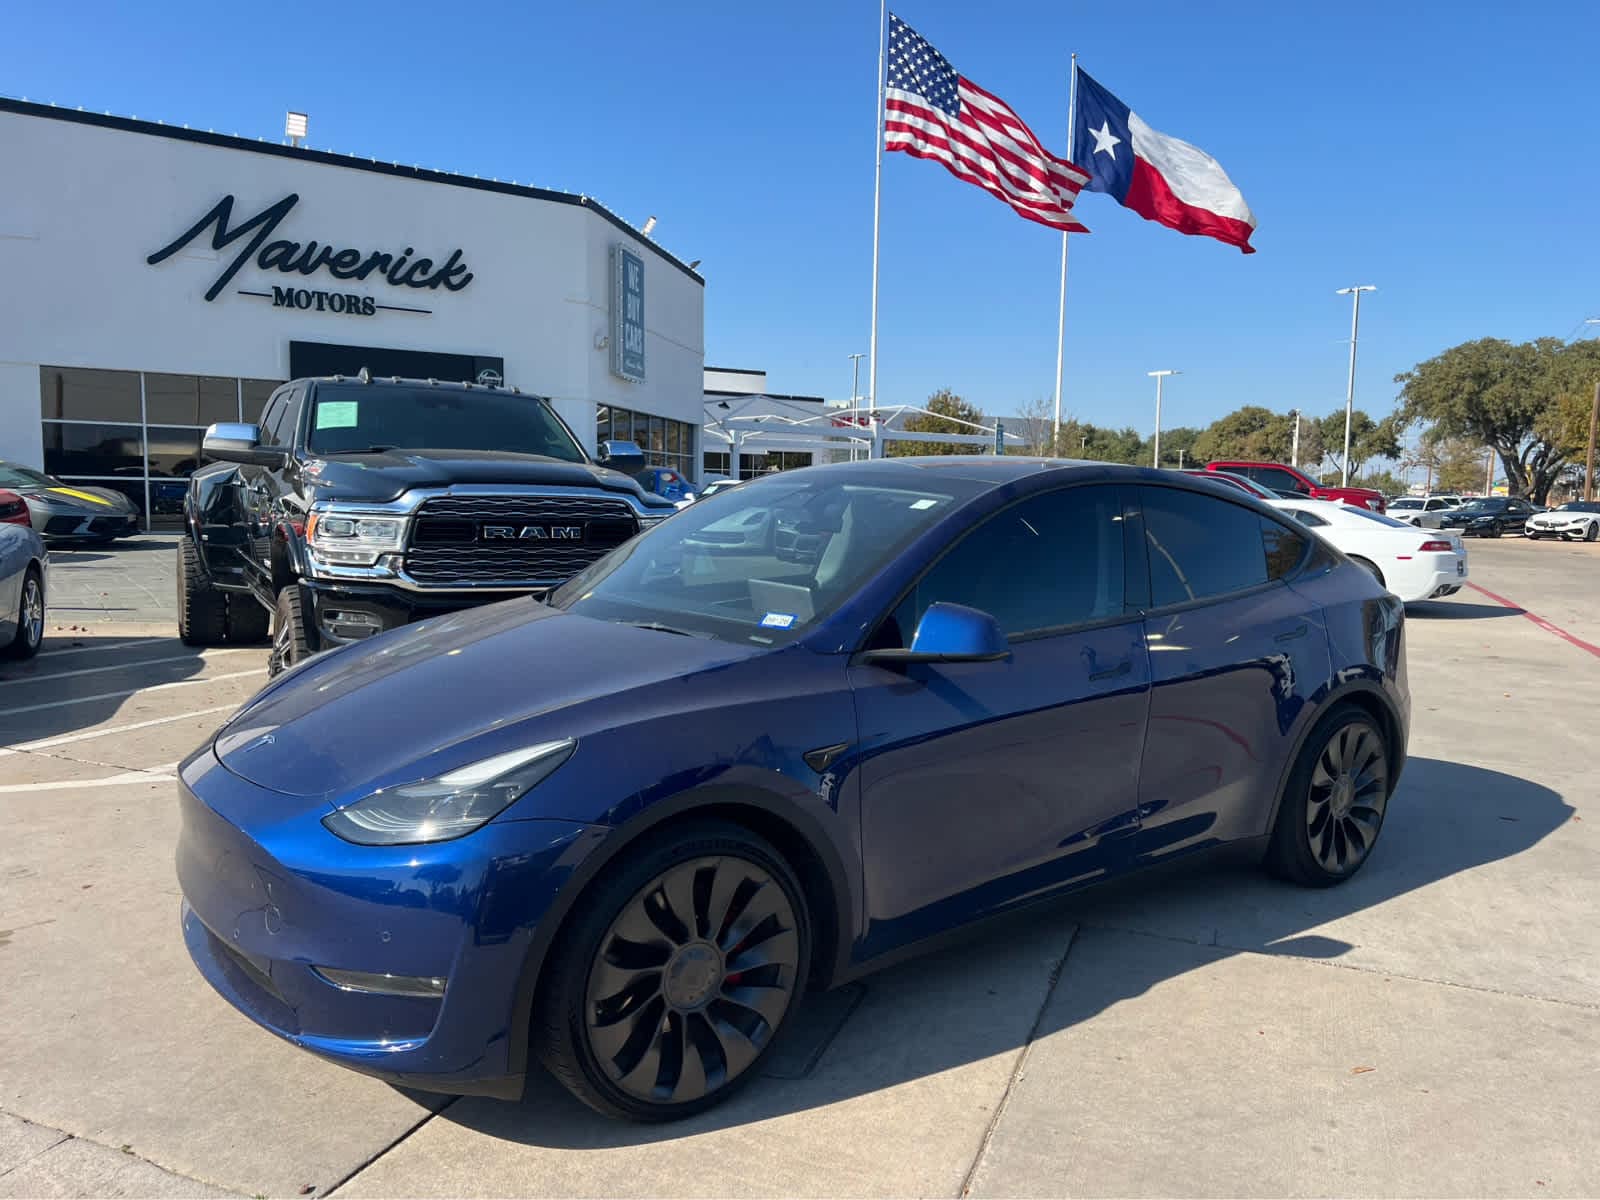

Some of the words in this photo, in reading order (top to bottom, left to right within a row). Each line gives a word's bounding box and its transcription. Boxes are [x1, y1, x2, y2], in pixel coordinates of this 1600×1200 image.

[147, 193, 473, 301] Maverick
[272, 286, 376, 316] MOTORS
[483, 525, 582, 540] RAM
